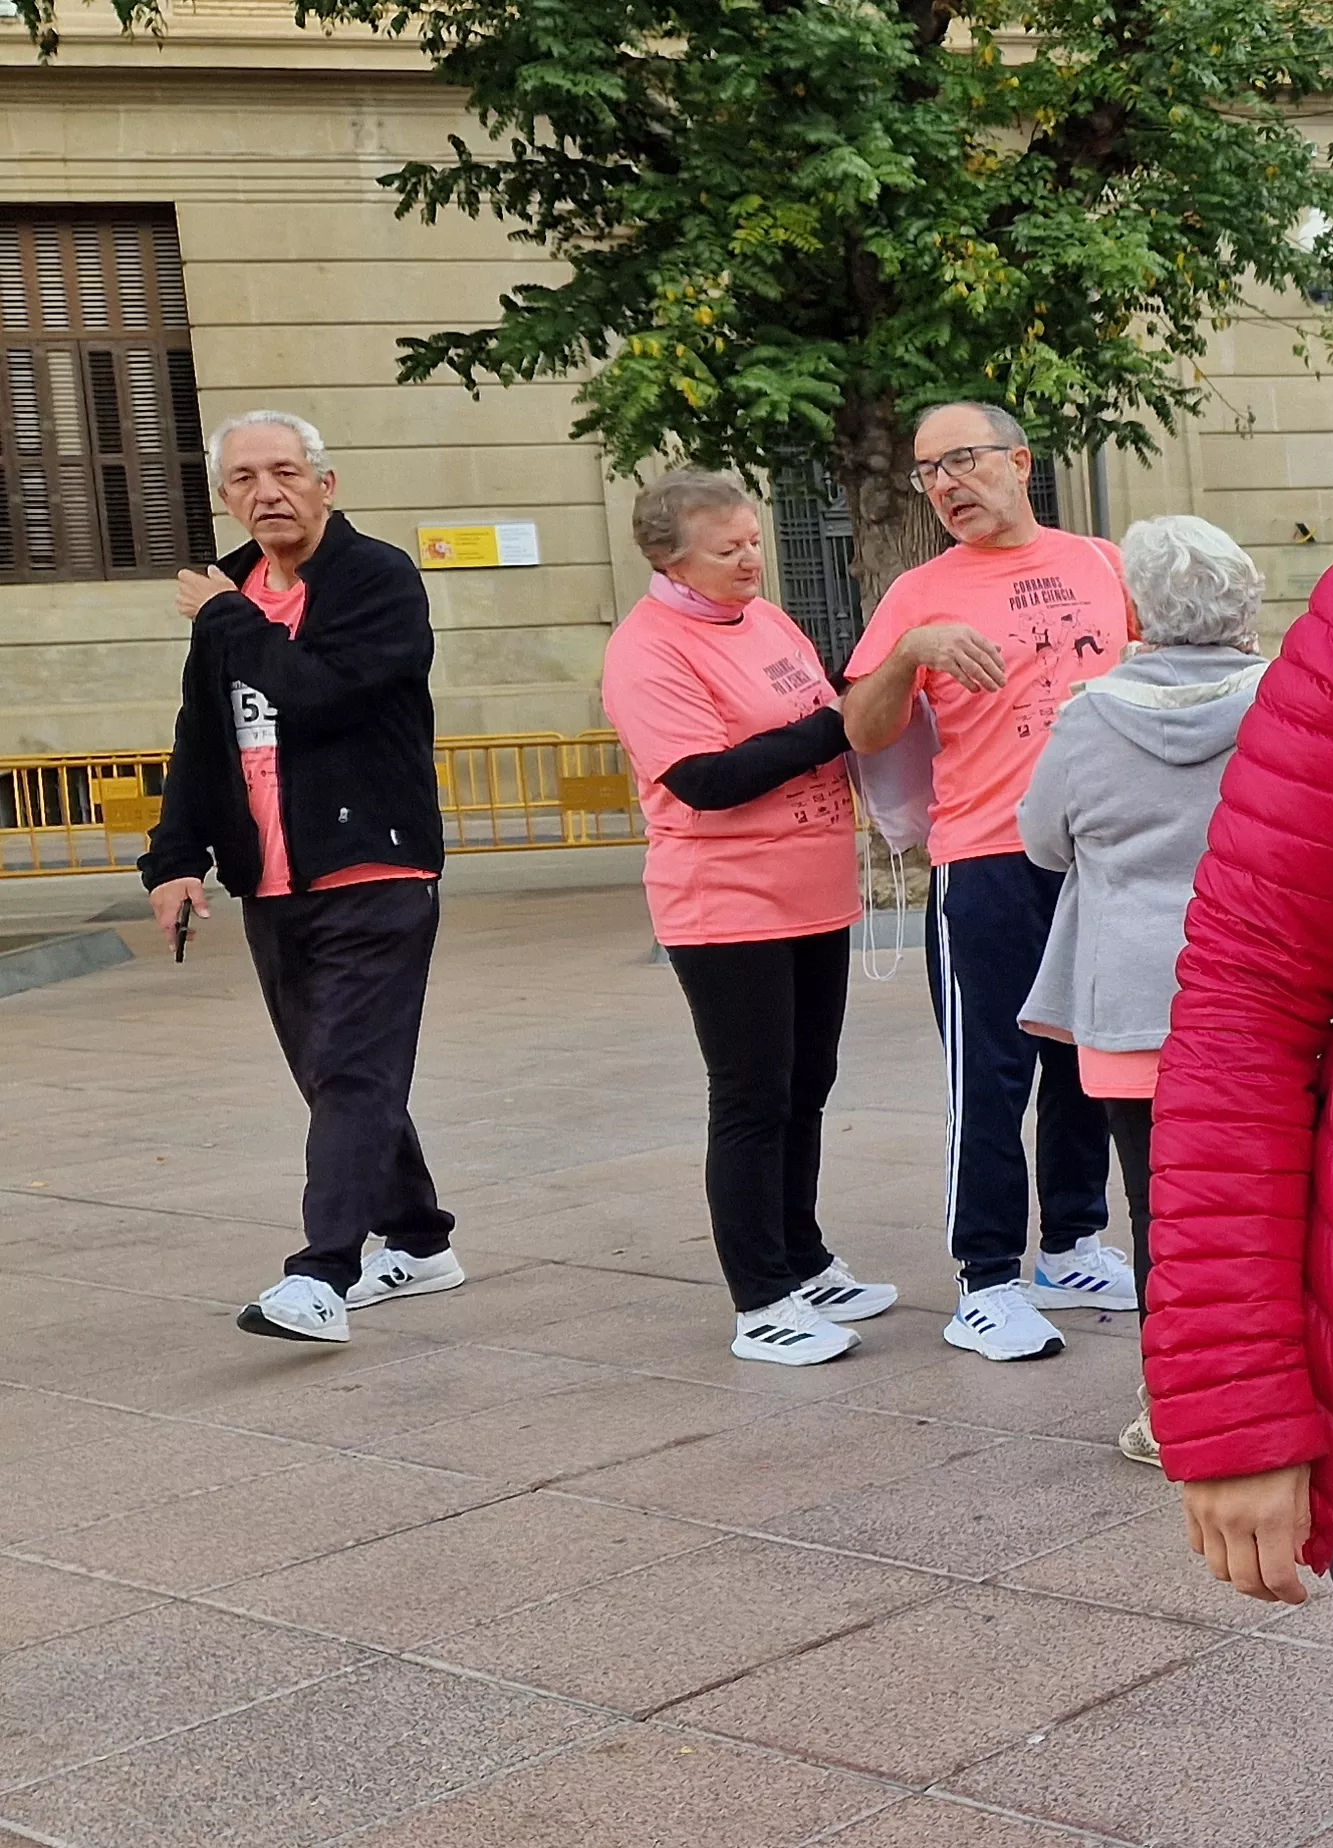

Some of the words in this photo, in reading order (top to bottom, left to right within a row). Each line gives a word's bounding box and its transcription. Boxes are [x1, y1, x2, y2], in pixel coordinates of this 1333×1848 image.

[1013, 576, 1062, 595] CORRAMOS
[1009, 594, 1028, 611] POR
[1030, 592, 1041, 606] LA
[1042, 588, 1077, 604] CIENCIA
